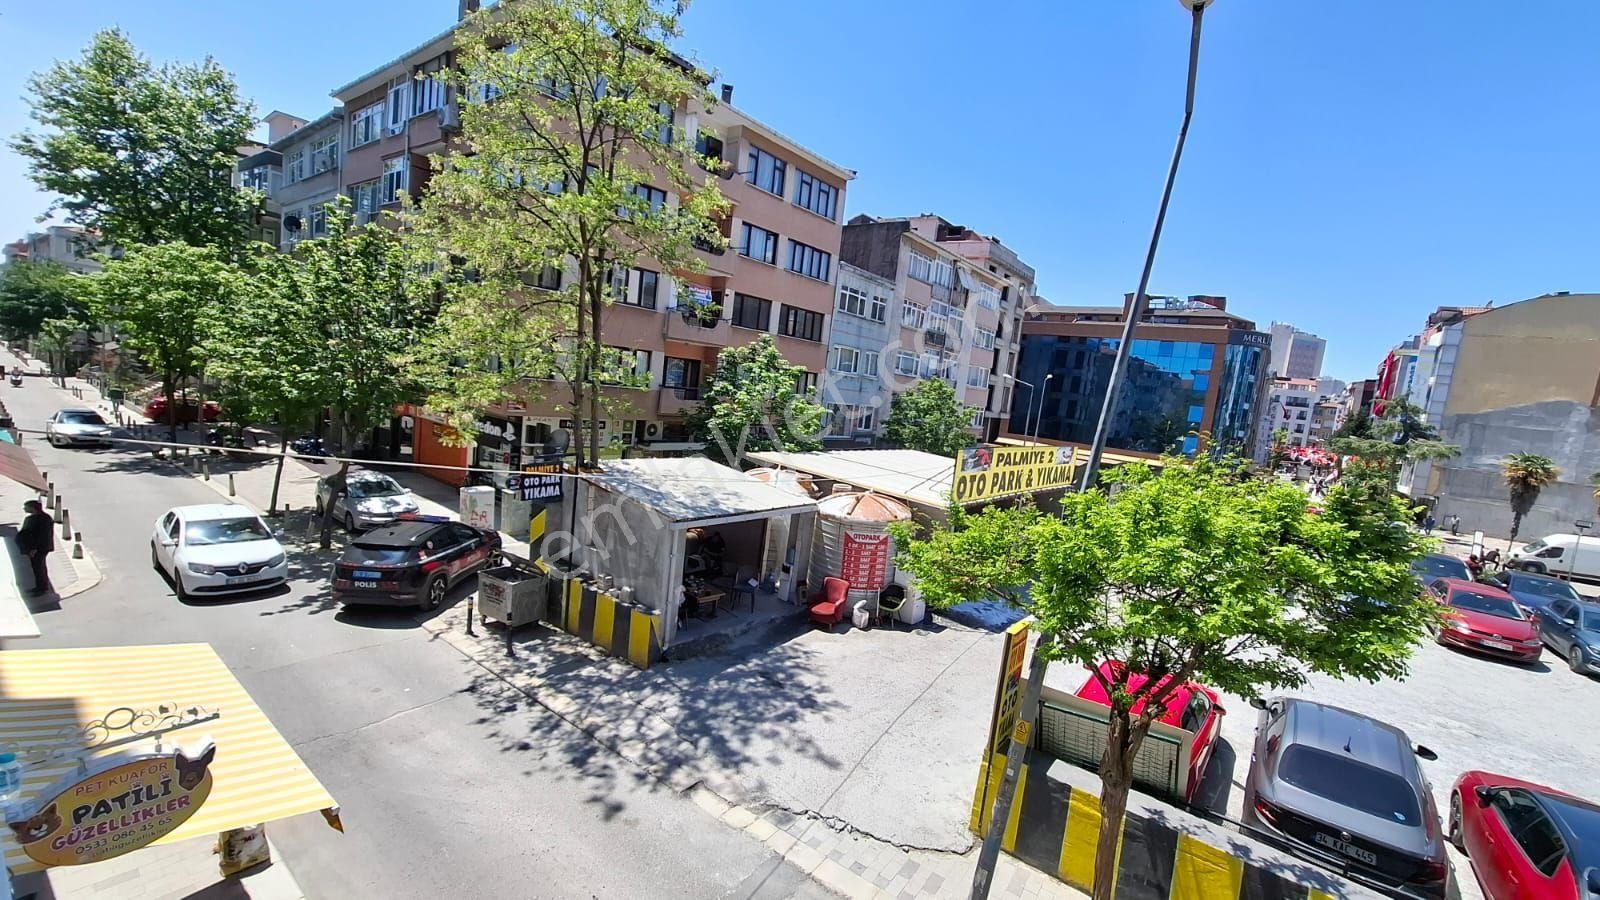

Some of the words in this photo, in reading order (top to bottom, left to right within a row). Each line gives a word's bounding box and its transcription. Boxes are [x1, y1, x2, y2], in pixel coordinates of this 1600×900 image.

[996, 451, 1045, 467] PALMIYE
[1047, 451, 1054, 463] 2
[524, 477, 540, 487] OTO
[541, 475, 560, 485] PARK
[956, 473, 987, 500] OTO
[990, 470, 1023, 494] PARK
[1025, 468, 1034, 488] &
[1037, 465, 1072, 487] YIKAMA
[524, 485, 560, 500] YIKAMA
[853, 533, 881, 541] OTOPARK
[75, 781, 103, 797] PET
[1316, 832, 1328, 845] 34
[75, 838, 108, 855] 0533
